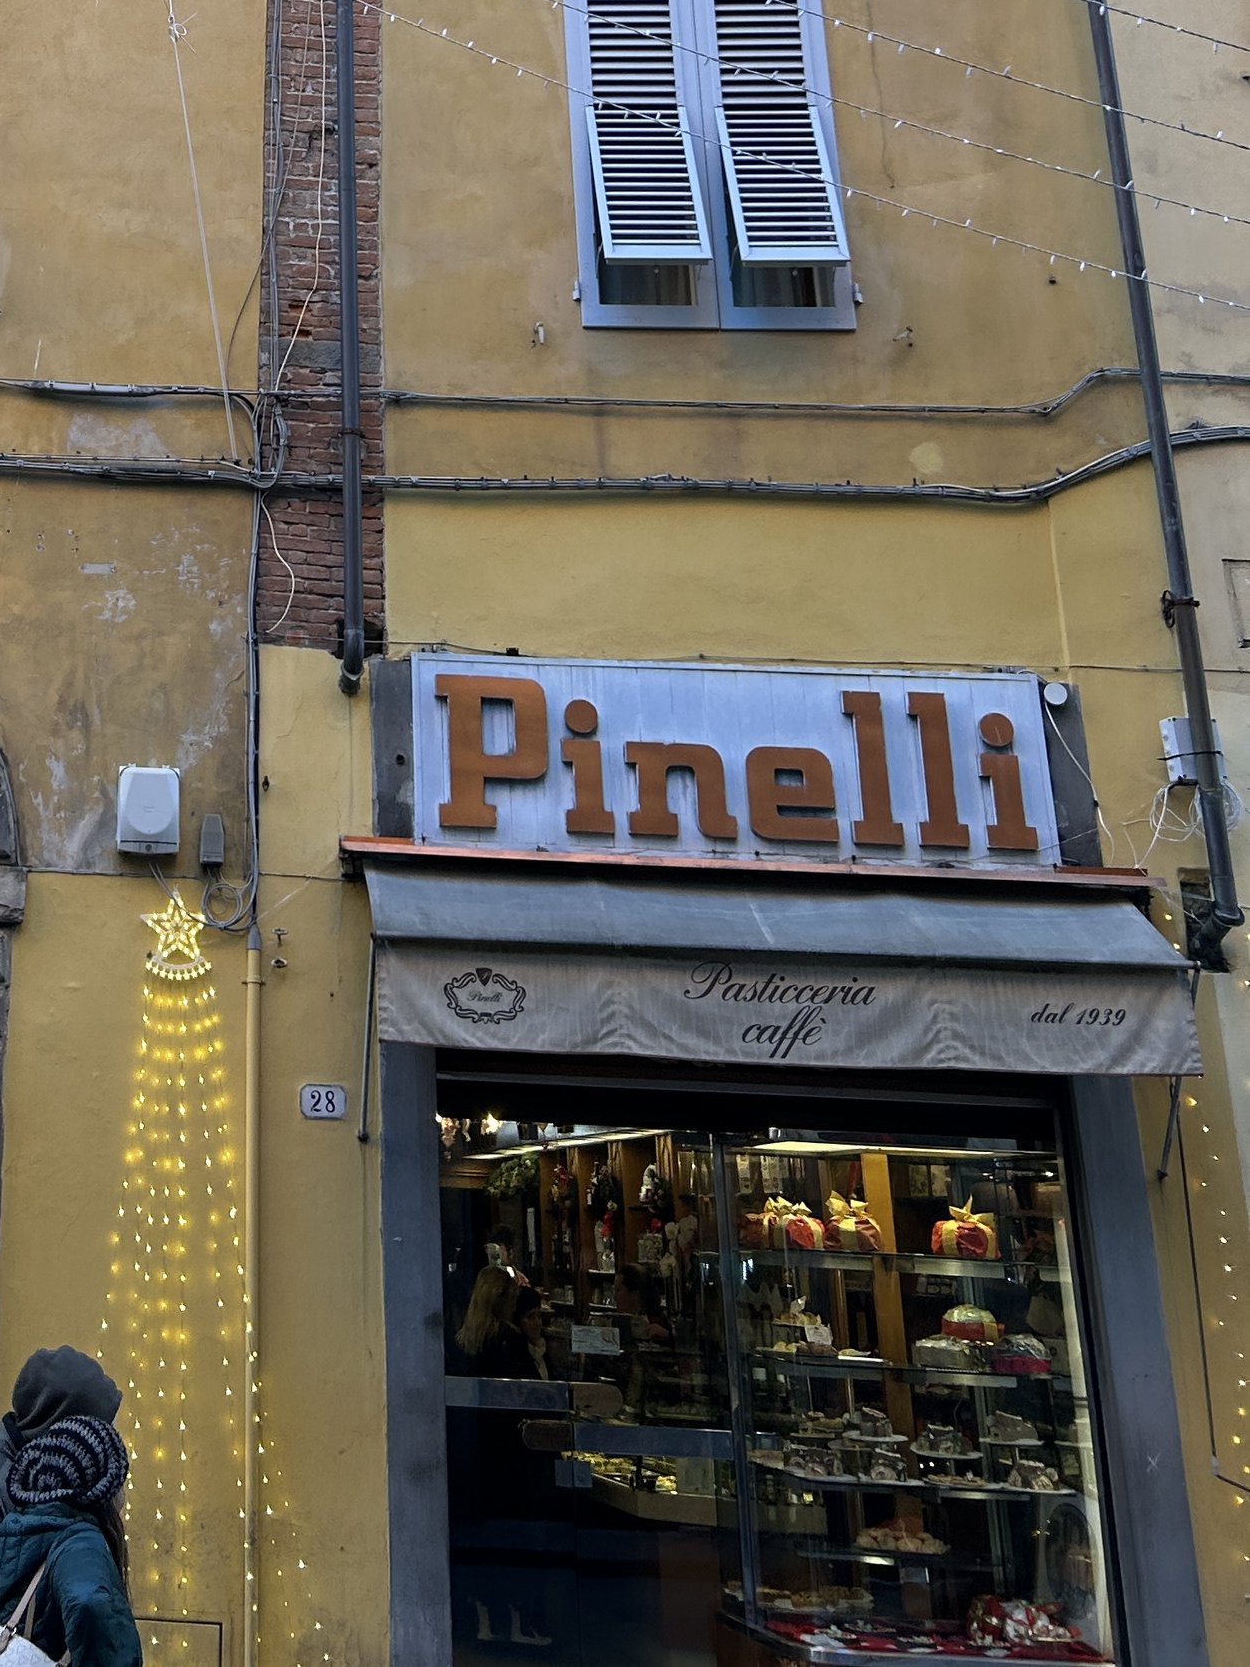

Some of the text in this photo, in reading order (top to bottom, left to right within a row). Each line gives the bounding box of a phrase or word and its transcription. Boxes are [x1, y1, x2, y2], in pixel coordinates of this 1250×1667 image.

[434, 673, 1039, 851] Pinelli
[683, 960, 877, 1006] Pasticceria
[741, 1005, 827, 1059] caffè
[1030, 1002, 1127, 1027] dal 1939
[310, 1089, 336, 1113] 28
